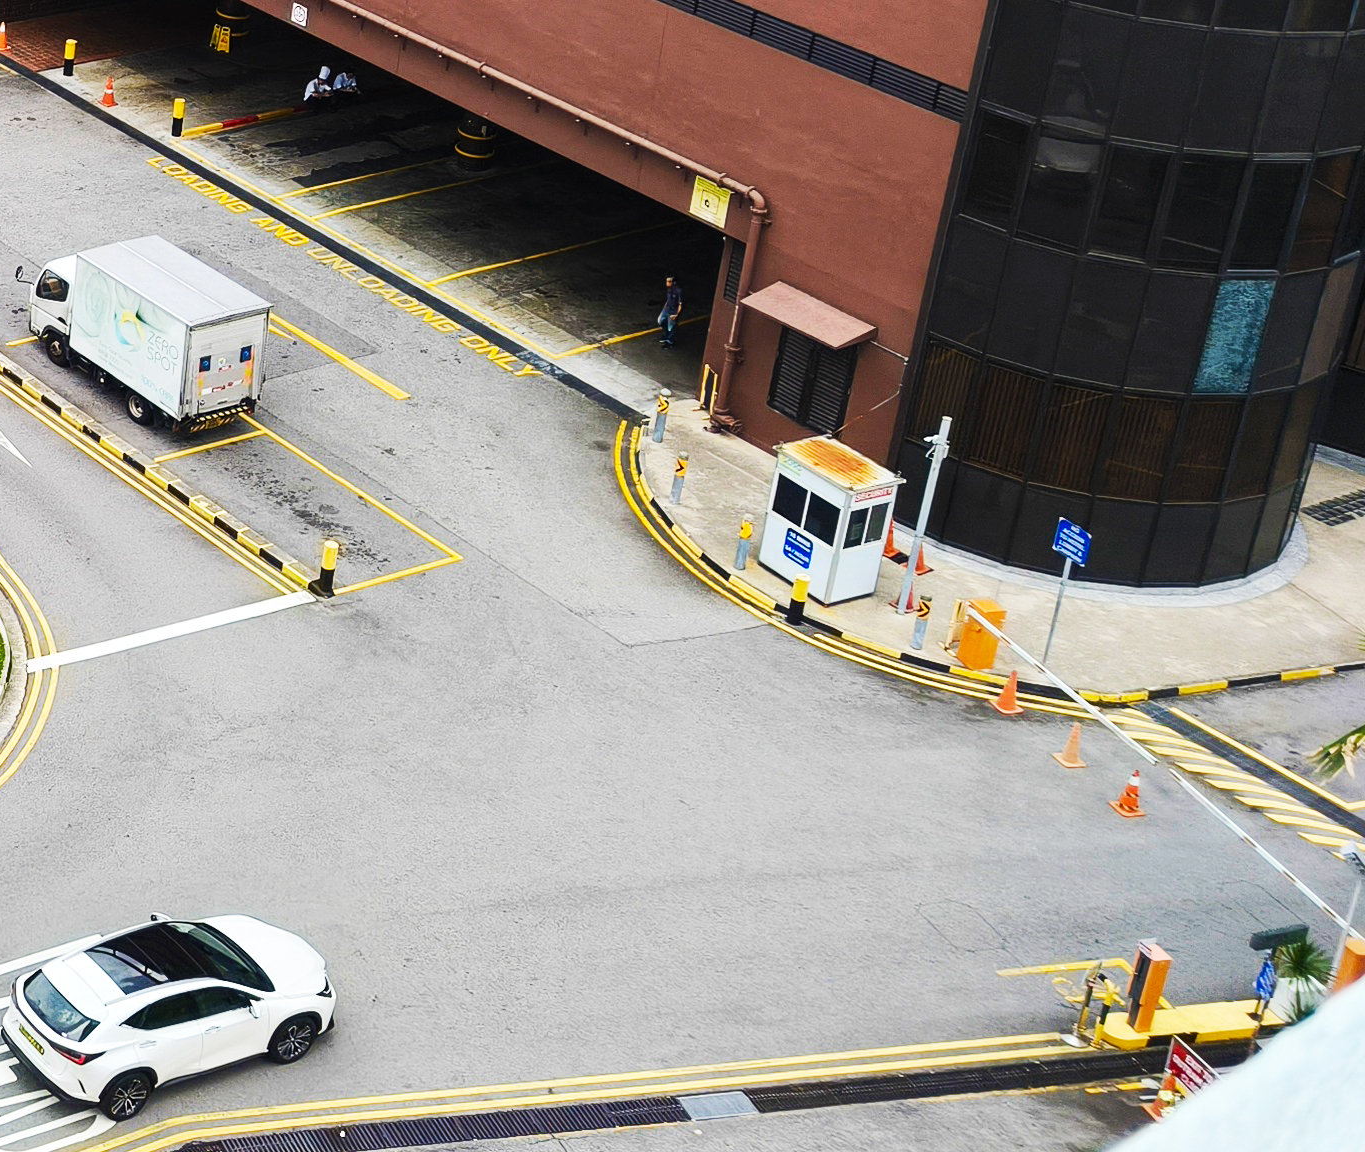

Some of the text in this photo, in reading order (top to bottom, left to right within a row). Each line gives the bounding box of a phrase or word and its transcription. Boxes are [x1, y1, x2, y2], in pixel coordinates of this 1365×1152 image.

[146, 156, 545, 378] LOADING AND UNLOADING ONLY
[147, 346, 177, 375] SPOT
[148, 330, 179, 361] ZERO
[854, 487, 894, 502] SECURITY
